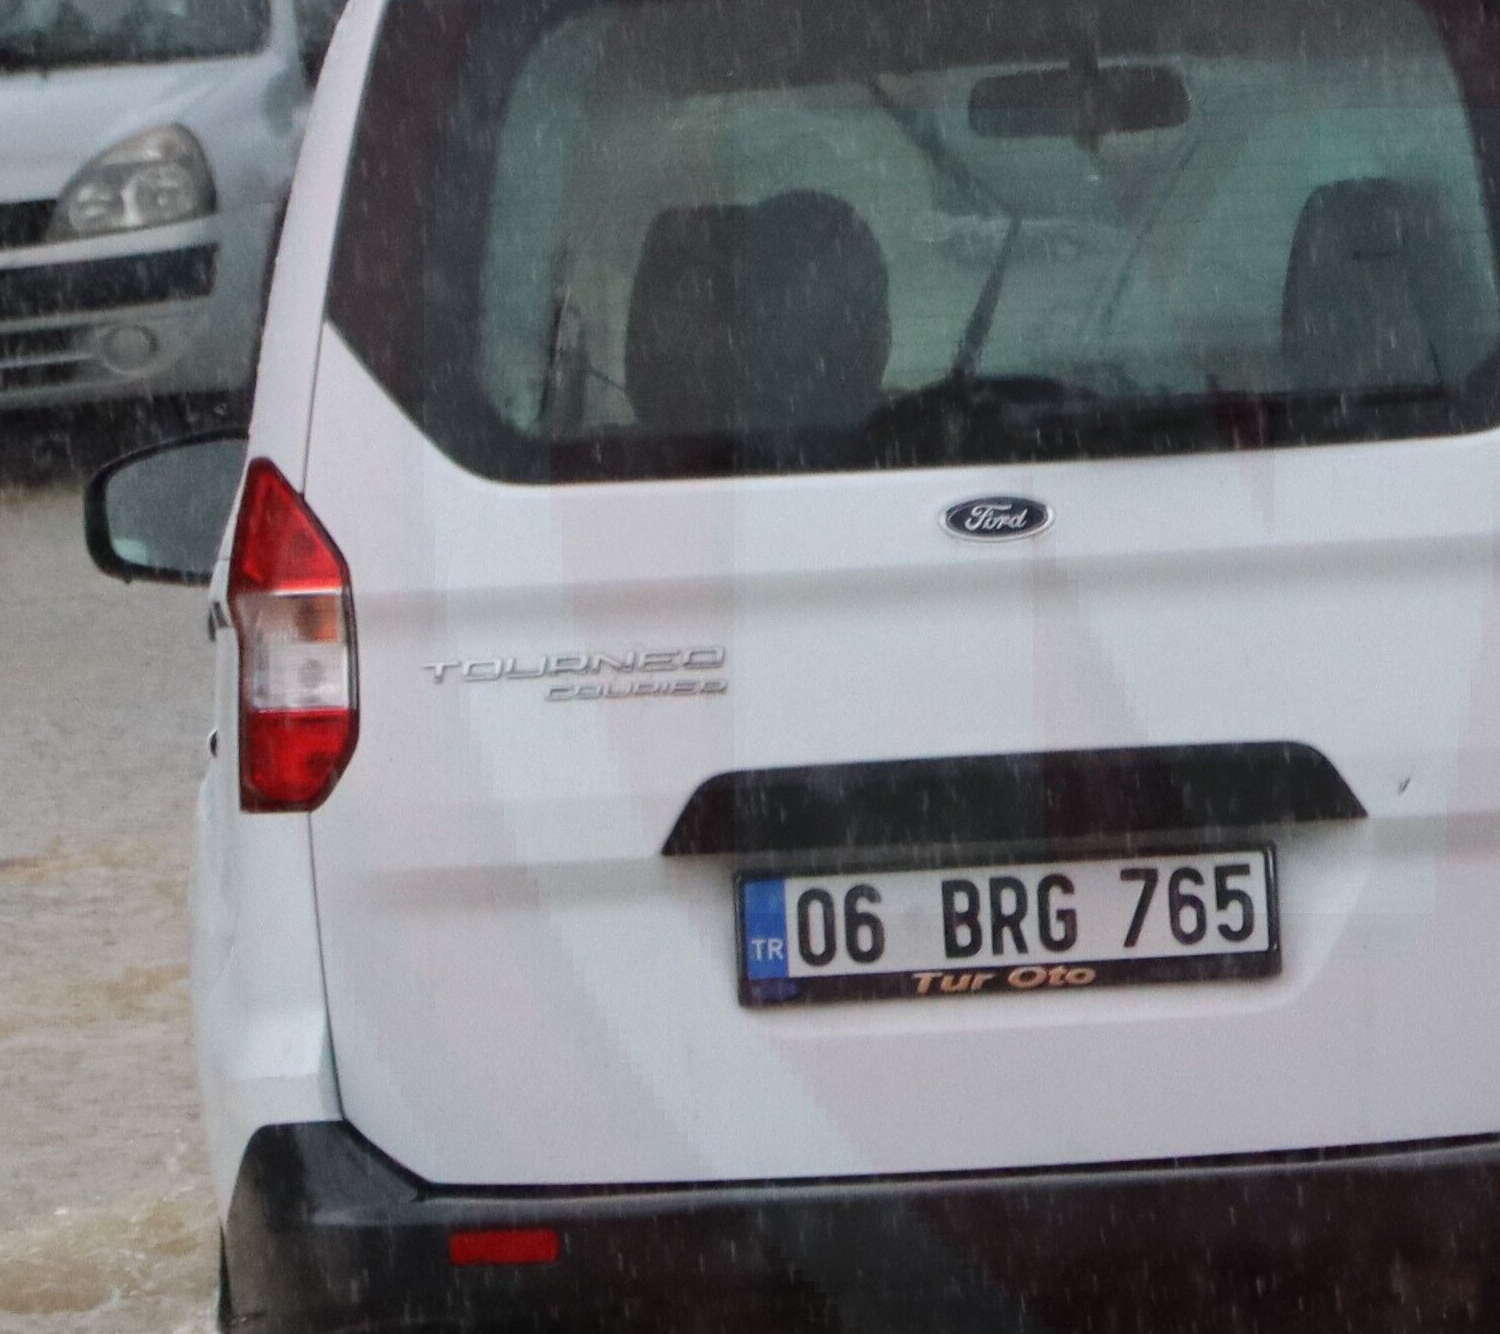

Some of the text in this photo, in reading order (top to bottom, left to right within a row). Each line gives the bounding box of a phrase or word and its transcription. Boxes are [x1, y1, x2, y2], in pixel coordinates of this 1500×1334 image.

[964, 503, 1029, 532] Ford
[423, 646, 726, 685] TOURNEO
[545, 678, 729, 703] COURIER
[798, 862, 1256, 967] 06 BRG 765
[751, 937, 785, 962] TR
[911, 964, 1097, 996] Tur Oto
